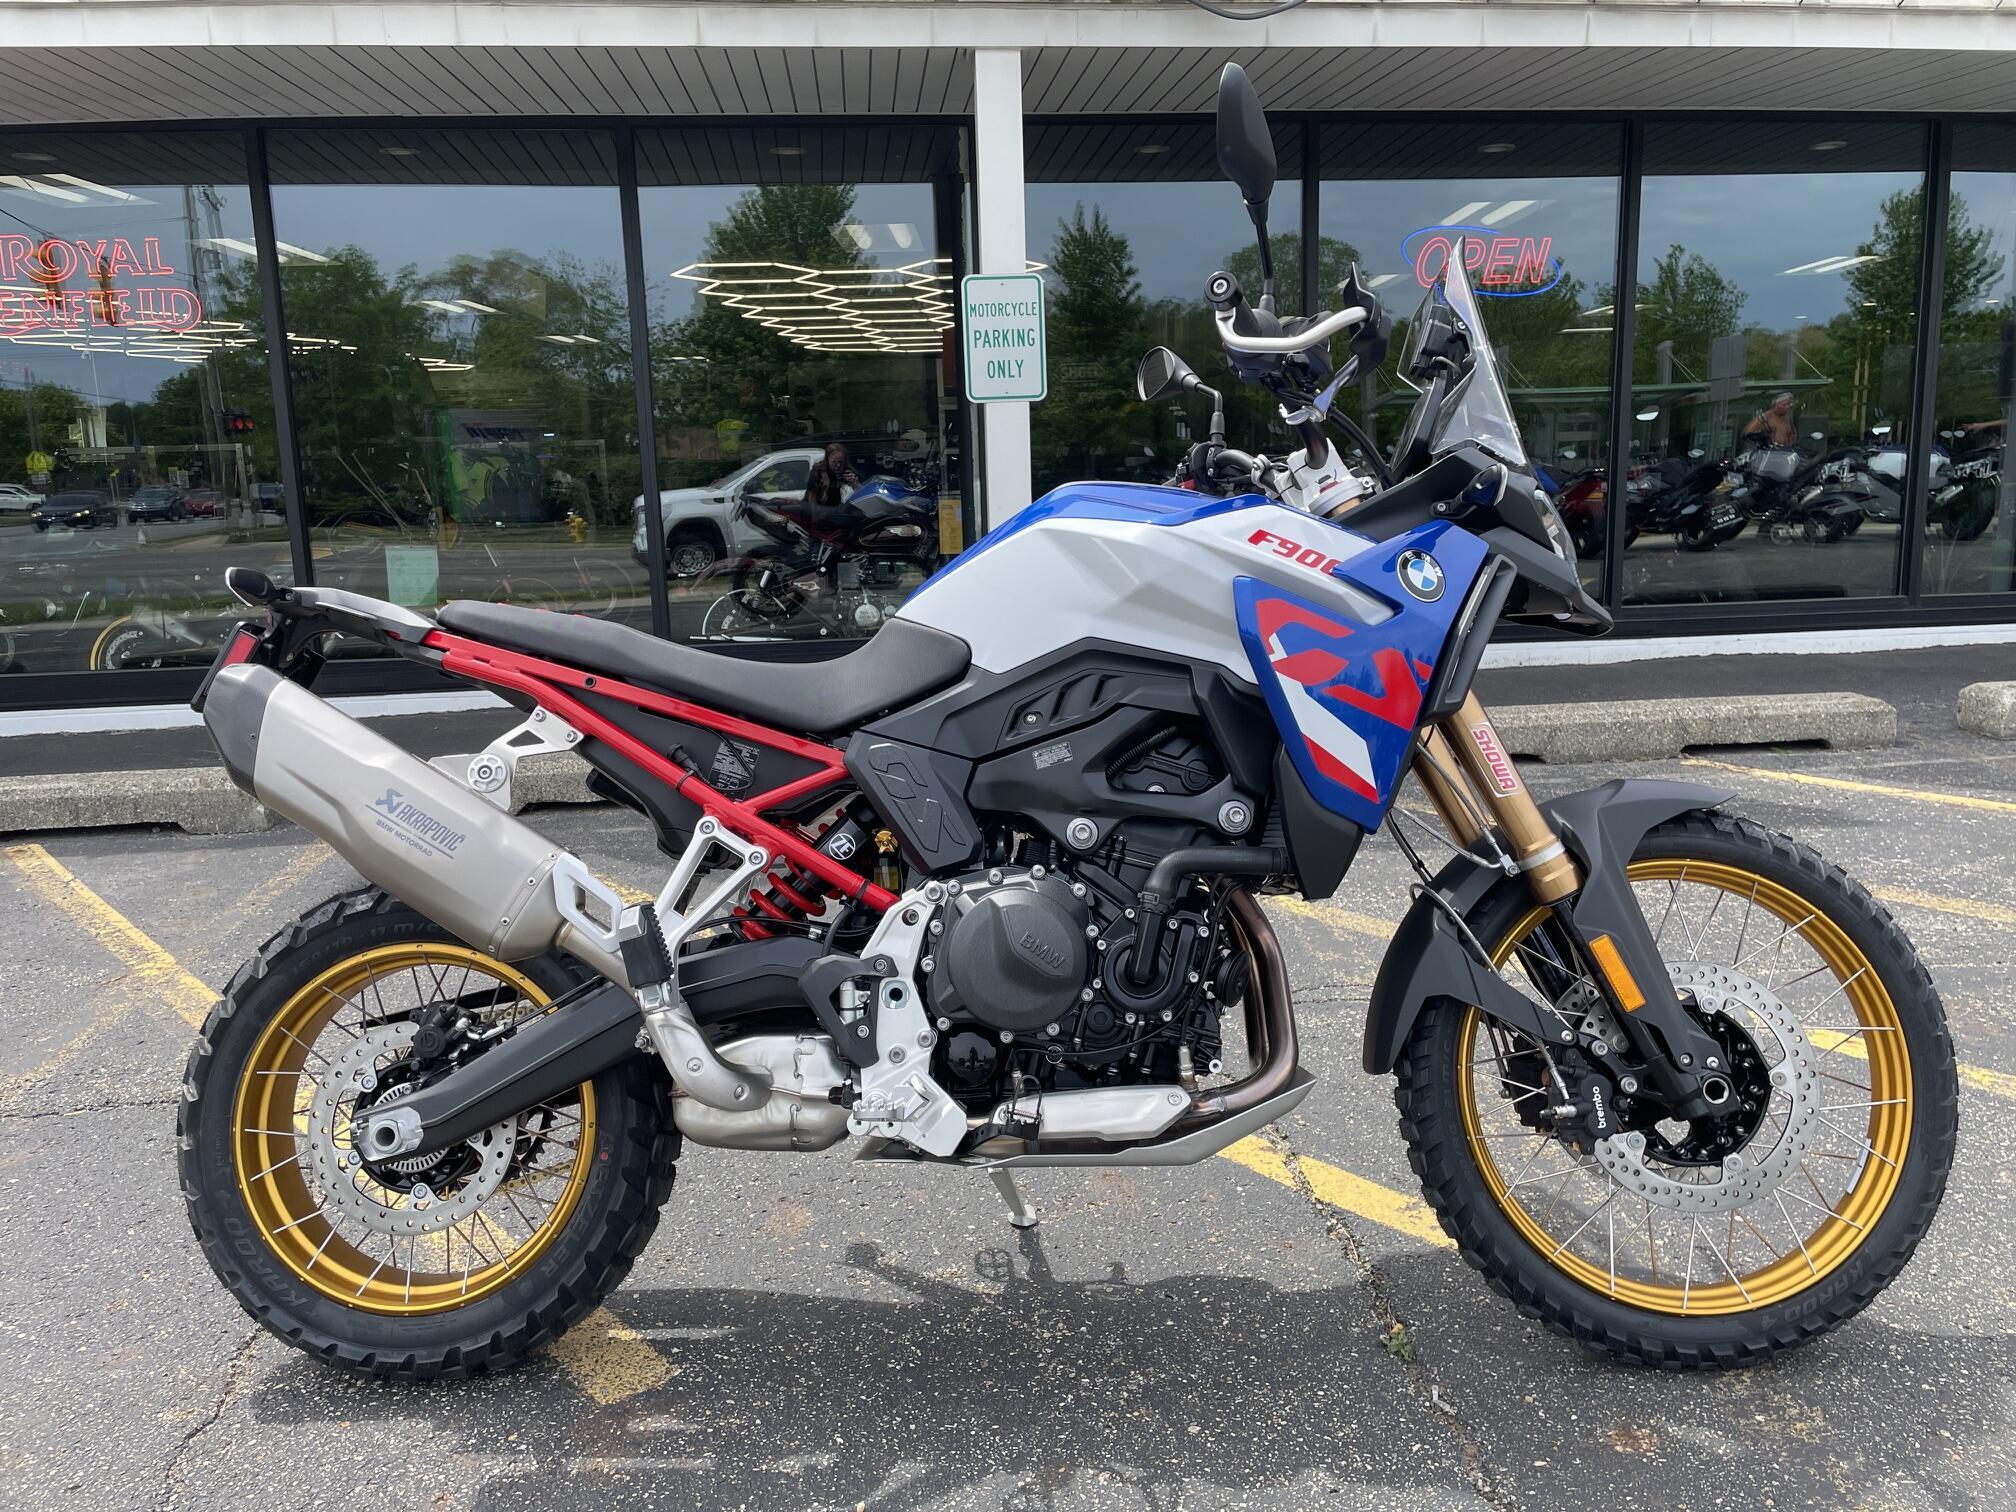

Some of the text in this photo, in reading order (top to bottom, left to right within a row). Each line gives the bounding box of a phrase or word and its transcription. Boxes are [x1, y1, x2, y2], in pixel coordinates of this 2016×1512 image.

[0, 233, 175, 284] ROYAL
[1416, 237, 1552, 289] OPEN
[969, 301, 1038, 318] MOTORCYCLE
[973, 328, 1035, 349] PARKING
[987, 359, 1025, 379] ONLY
[1472, 729, 1517, 790] SHOWA
[375, 819, 433, 857] BMW MOTORRAD
[1019, 930, 1066, 969] BMW
[1592, 1086, 1607, 1129] brembo
[223, 1217, 308, 1307] KAROO
[1784, 1258, 1864, 1322] KAROO
